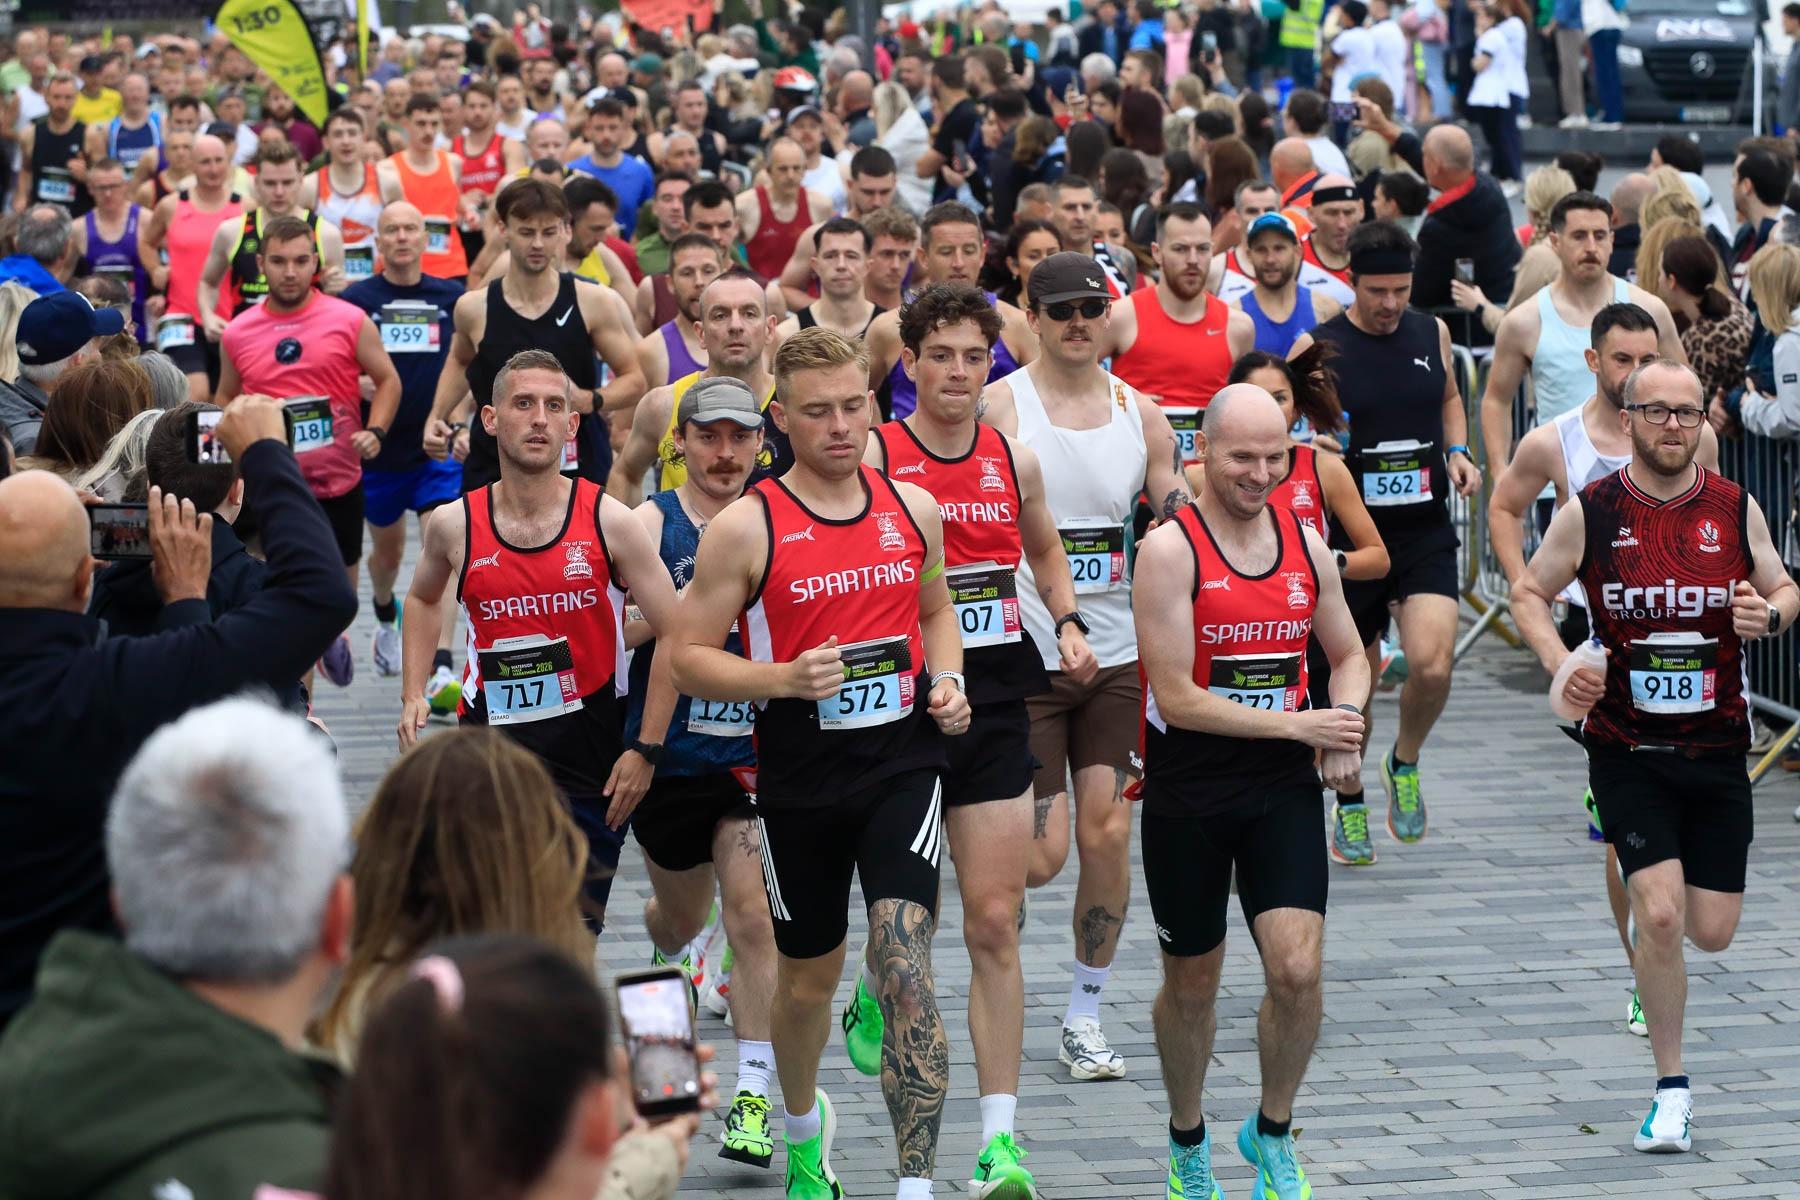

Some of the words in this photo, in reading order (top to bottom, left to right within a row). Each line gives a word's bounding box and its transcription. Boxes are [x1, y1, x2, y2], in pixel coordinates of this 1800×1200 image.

[390, 327, 422, 342] 959
[1376, 475, 1414, 495] 562
[563, 562, 593, 577] SPARTANS
[1067, 558, 1101, 581] 20
[790, 559, 915, 604] SPARTANS
[982, 586, 998, 598] 2026
[1602, 578, 1737, 618] Errigal
[479, 588, 598, 621] SPARTANS
[1003, 603, 1013, 623] WAVE
[1609, 608, 1676, 620] GROUP
[1200, 619, 1311, 644] SPARTANS
[536, 661, 553, 673] 2026
[878, 660, 895, 673] 2026
[560, 674, 572, 692] WAVE
[900, 676, 910, 695] WAVE
[1644, 676, 1693, 700] 918
[501, 680, 544, 710] 717
[839, 682, 888, 715] 572
